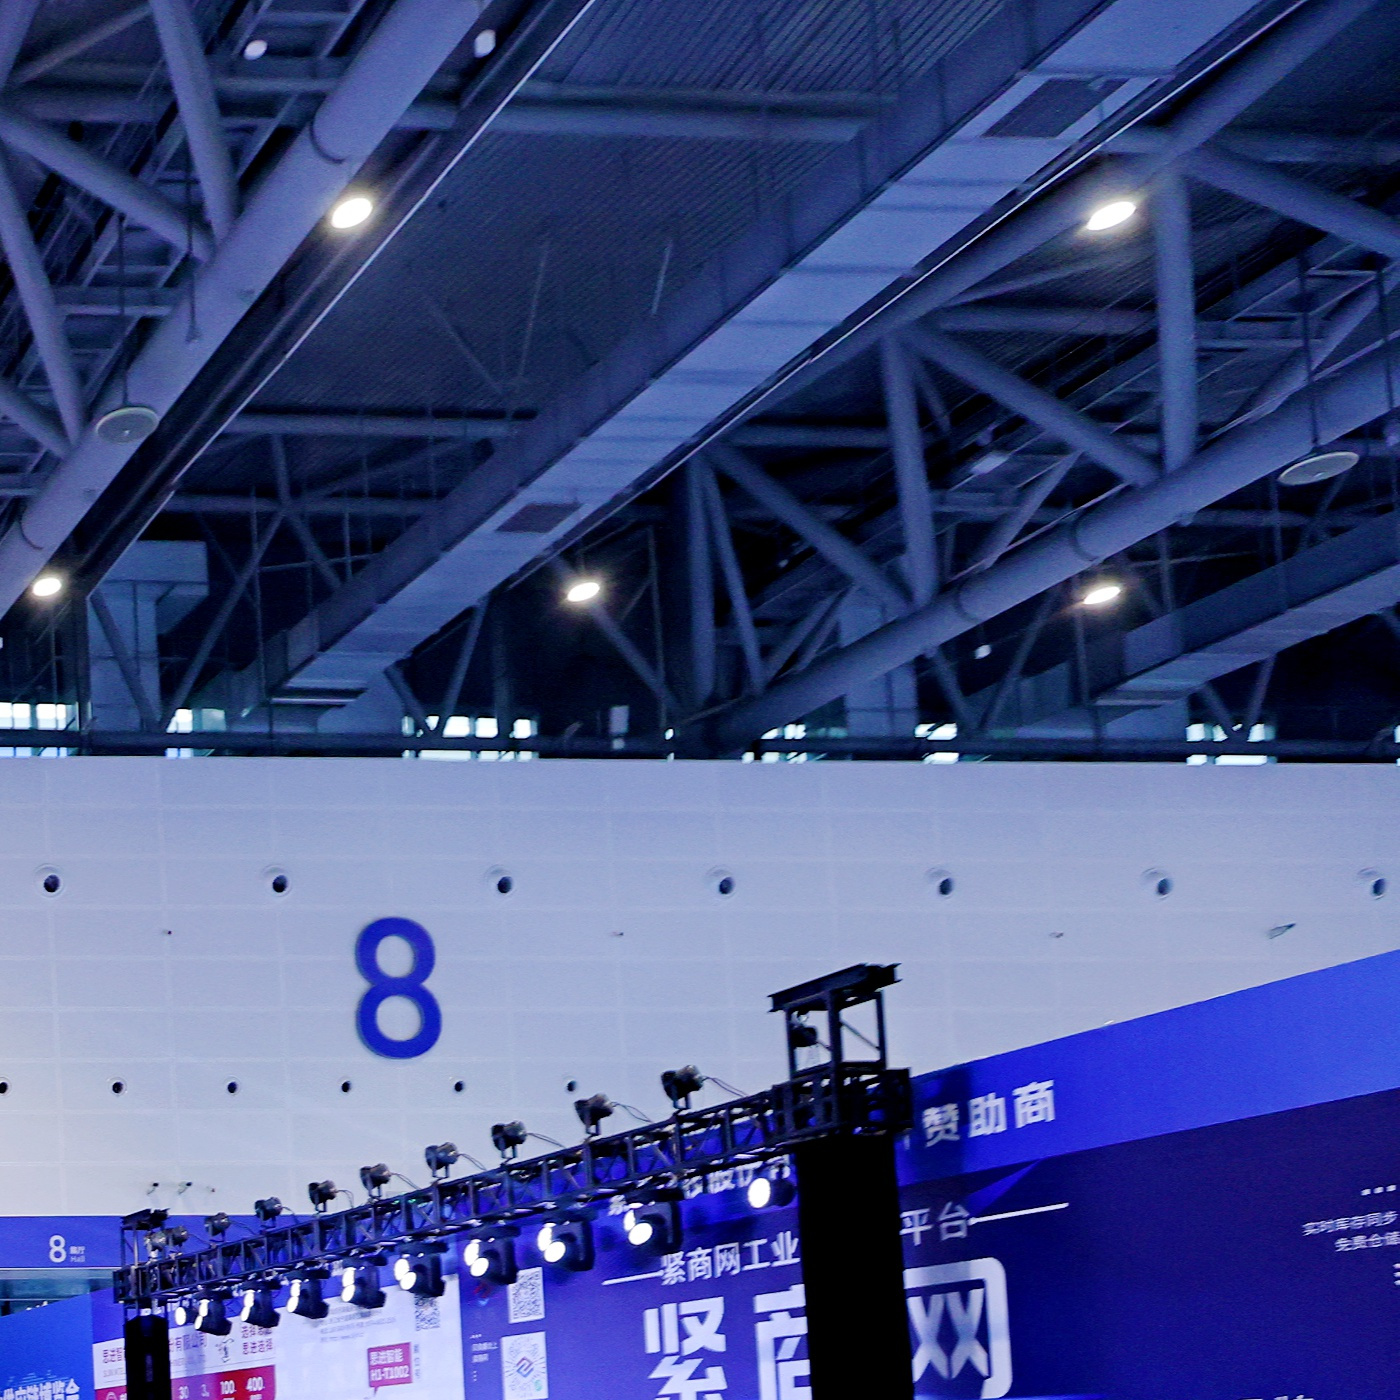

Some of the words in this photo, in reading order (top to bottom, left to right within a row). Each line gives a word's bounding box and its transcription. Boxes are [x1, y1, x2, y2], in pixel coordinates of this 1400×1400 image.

[355, 916, 442, 1060] 8
[922, 1079, 1056, 1148] 赞助商
[49, 1234, 67, 1263] 8
